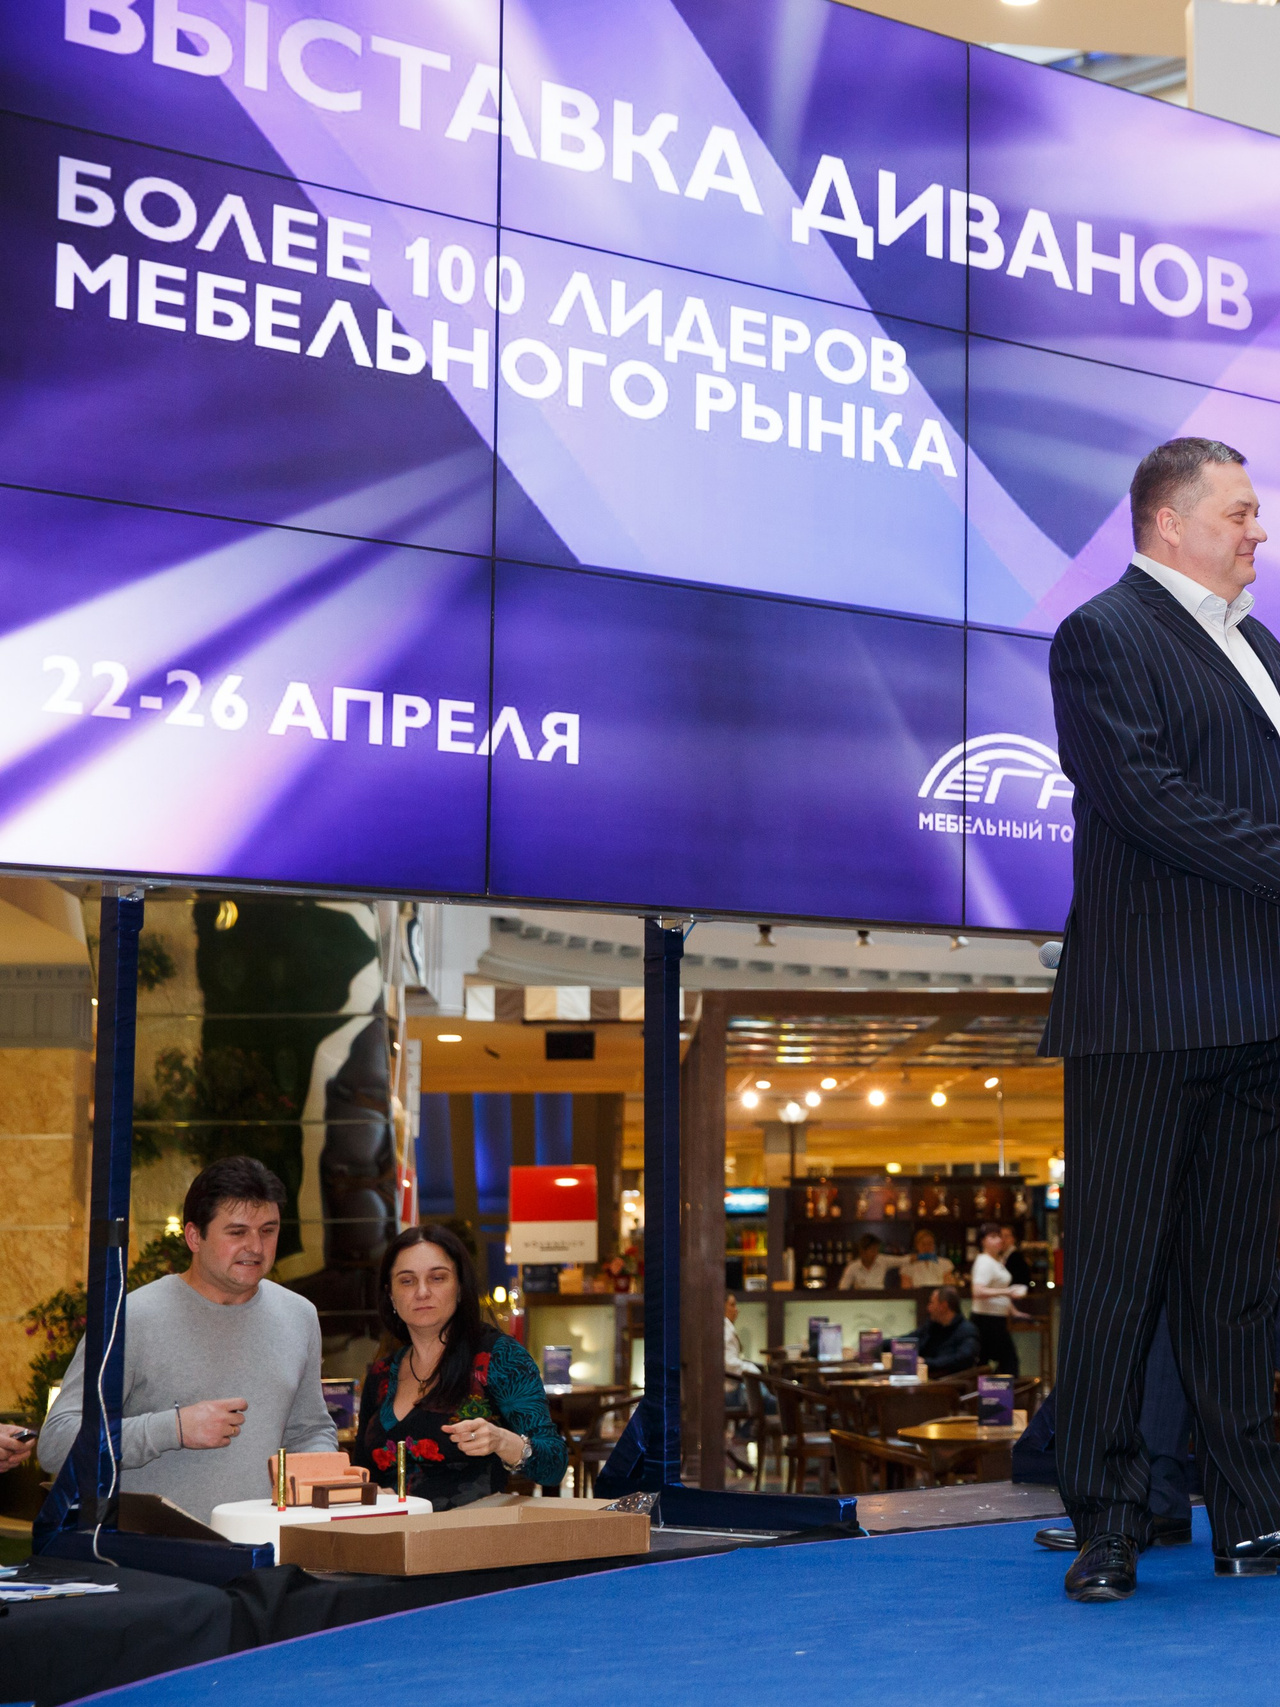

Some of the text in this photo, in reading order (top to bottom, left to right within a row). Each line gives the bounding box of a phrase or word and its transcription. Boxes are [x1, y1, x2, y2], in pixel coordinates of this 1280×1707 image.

[57, 155, 911, 396] БОЛЕЕ 100 ЛИДЕРОВ
[64, 0, 1253, 331] ВЫСТАВКА ДИВАНОВ
[55, 242, 958, 478] МЕБЕЛЬНОГО РЫНКА
[41, 654, 580, 765] 22-26 АПРЕЛЯ
[918, 812, 1043, 840] МЕБЕЛЬНЫЙ
